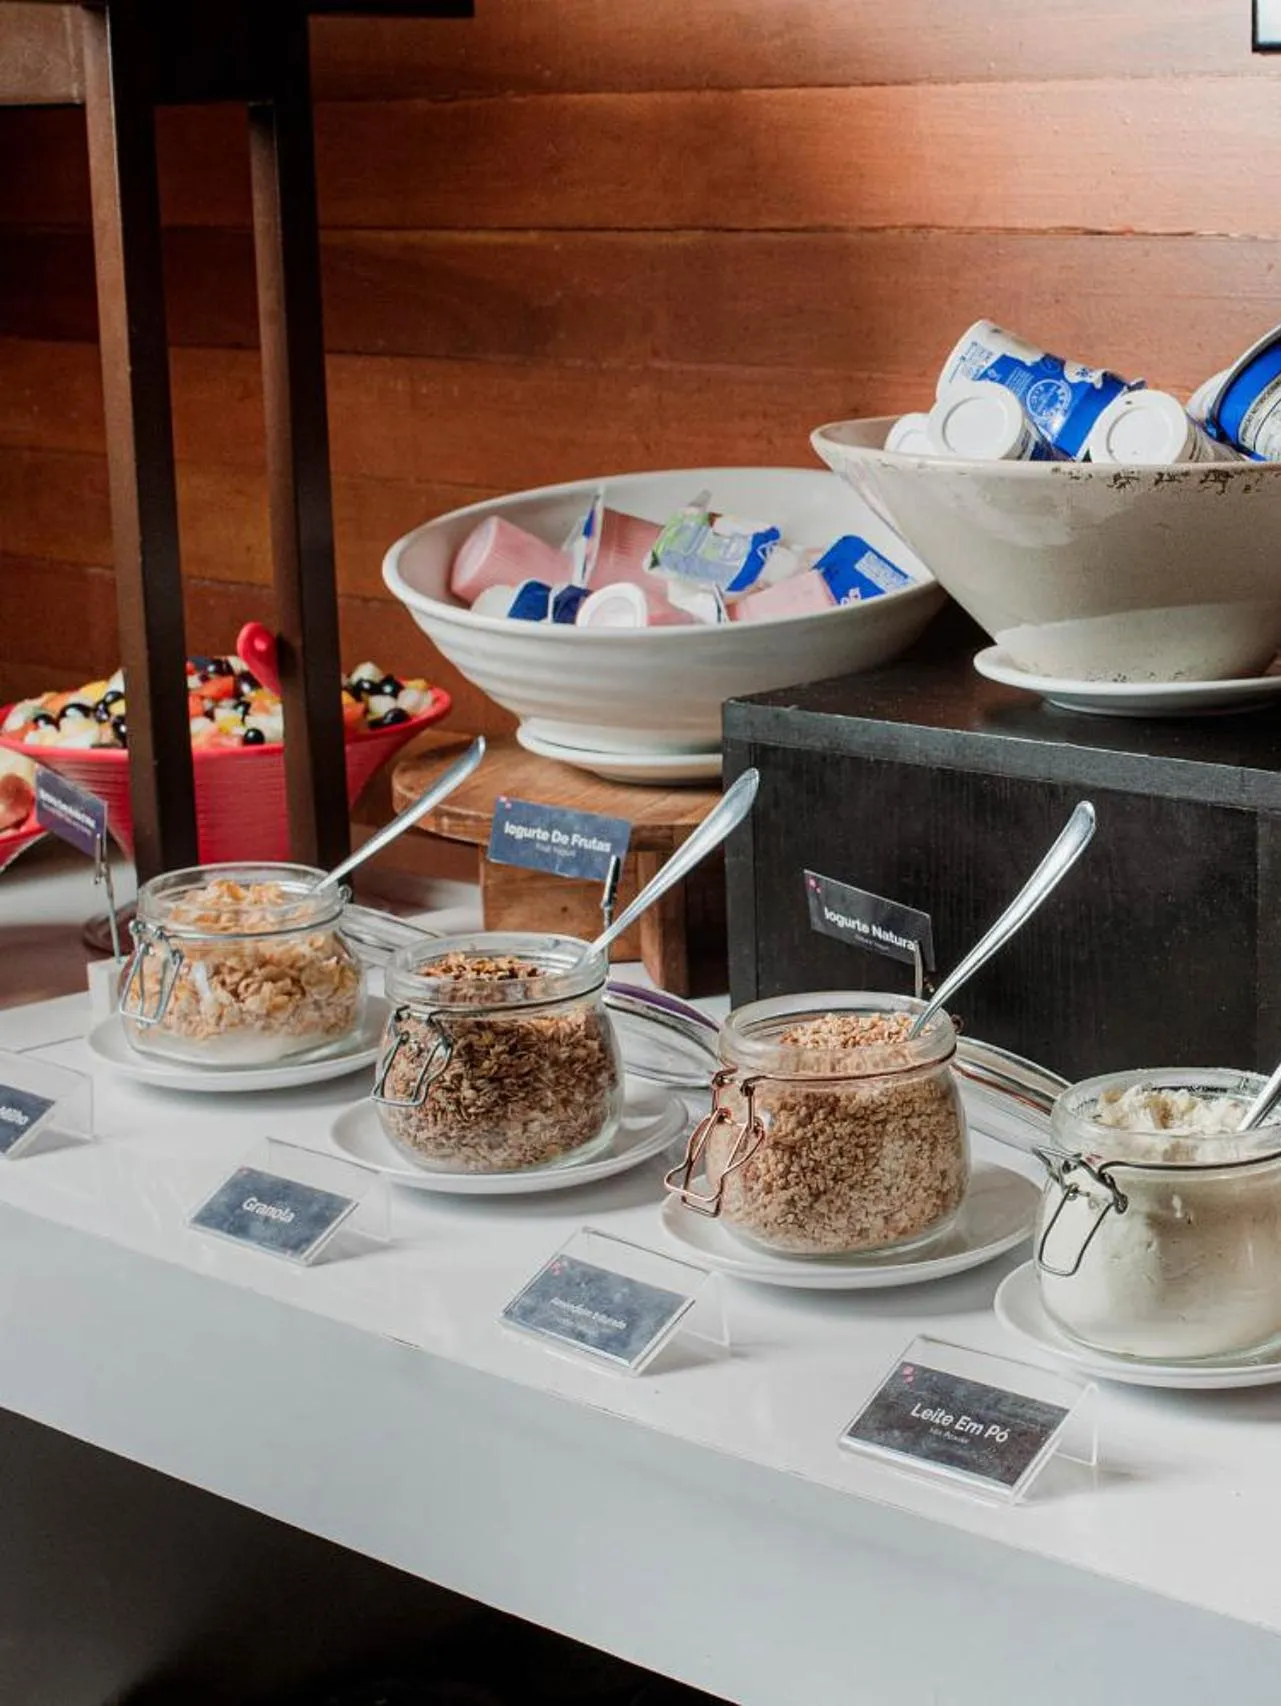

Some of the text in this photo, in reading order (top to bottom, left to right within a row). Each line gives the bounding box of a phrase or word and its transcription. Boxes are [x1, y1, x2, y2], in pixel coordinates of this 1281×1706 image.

[503, 820, 549, 842] Iogurte
[551, 829, 569, 845] De
[571, 834, 612, 853] Frutas
[823, 905, 870, 934] Iogurte
[242, 1196, 296, 1223] Granola
[910, 1402, 954, 1427] Leite
[954, 1415, 983, 1436] Em
[983, 1425, 1009, 1444] Pó
